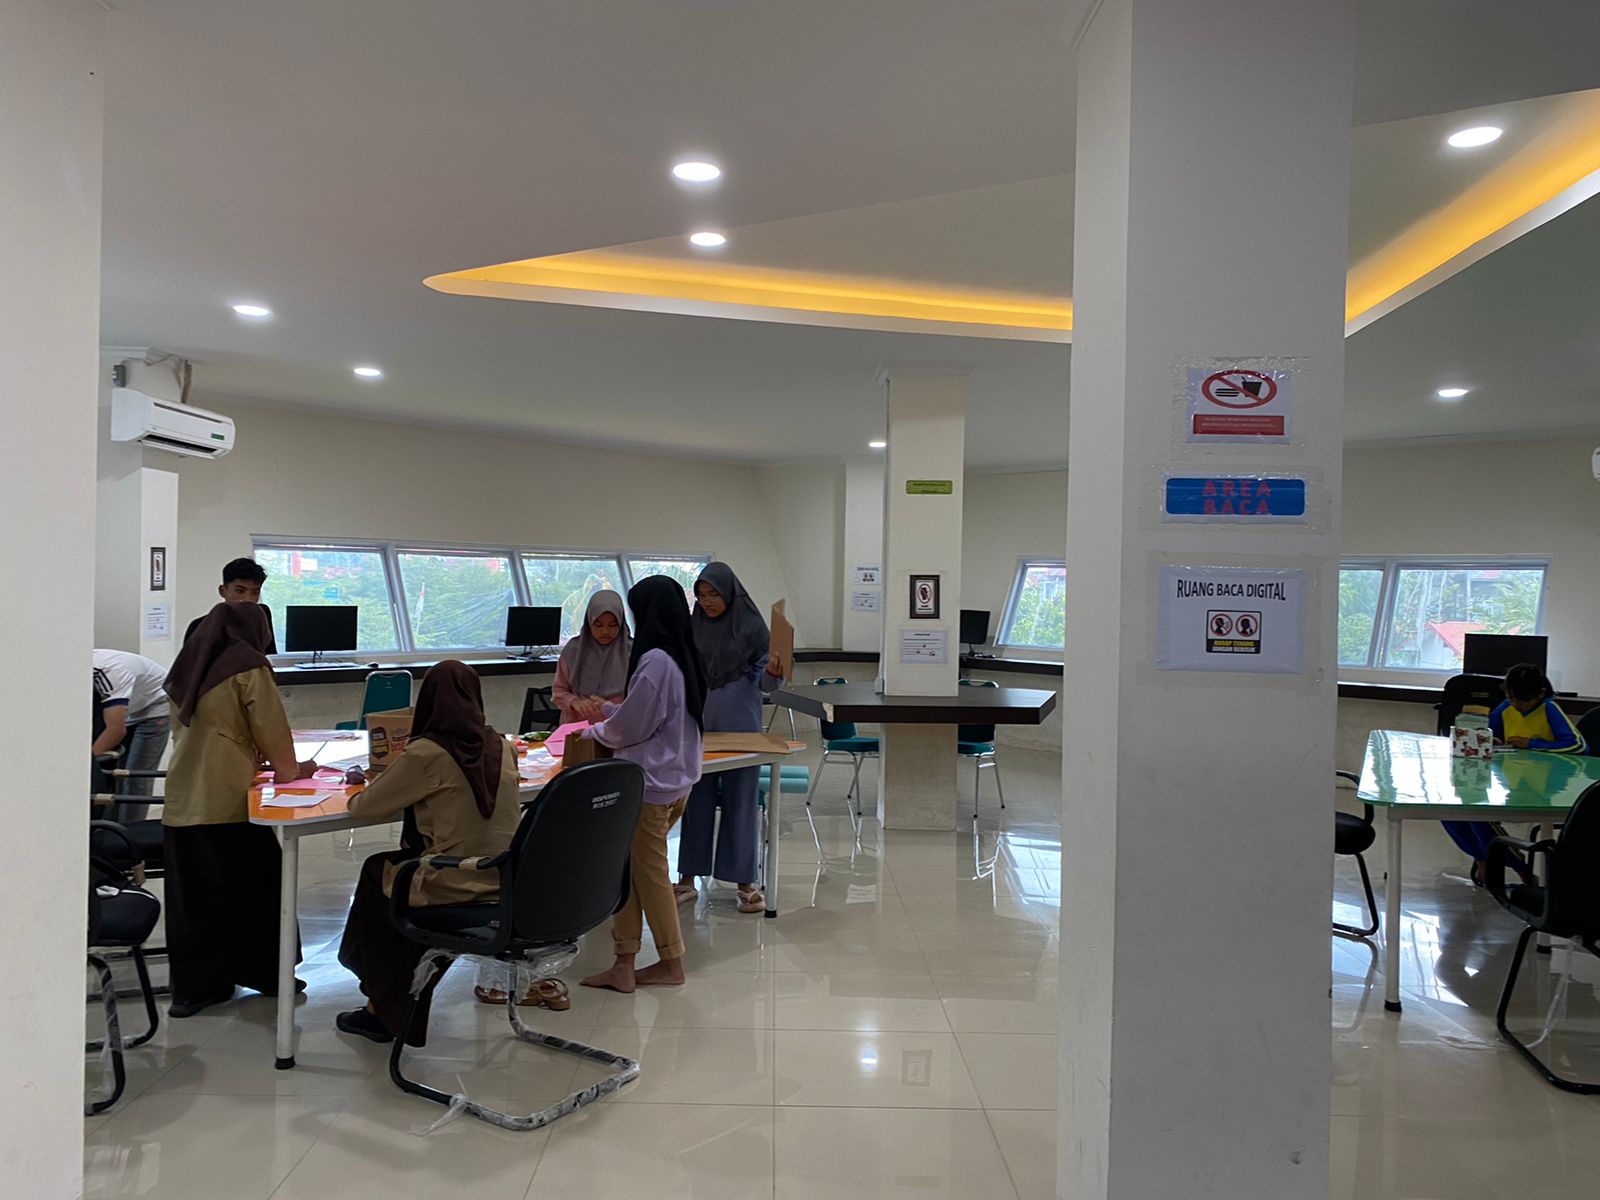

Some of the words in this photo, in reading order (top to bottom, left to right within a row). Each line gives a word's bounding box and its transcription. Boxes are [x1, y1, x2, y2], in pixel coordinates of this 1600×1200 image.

[1203, 480, 1271, 496] AREA
[1204, 499, 1271, 515] BACA
[1177, 579, 1214, 598] RUANG
[1217, 583, 1244, 597] BACA
[1246, 582, 1286, 601] DIGITAL
